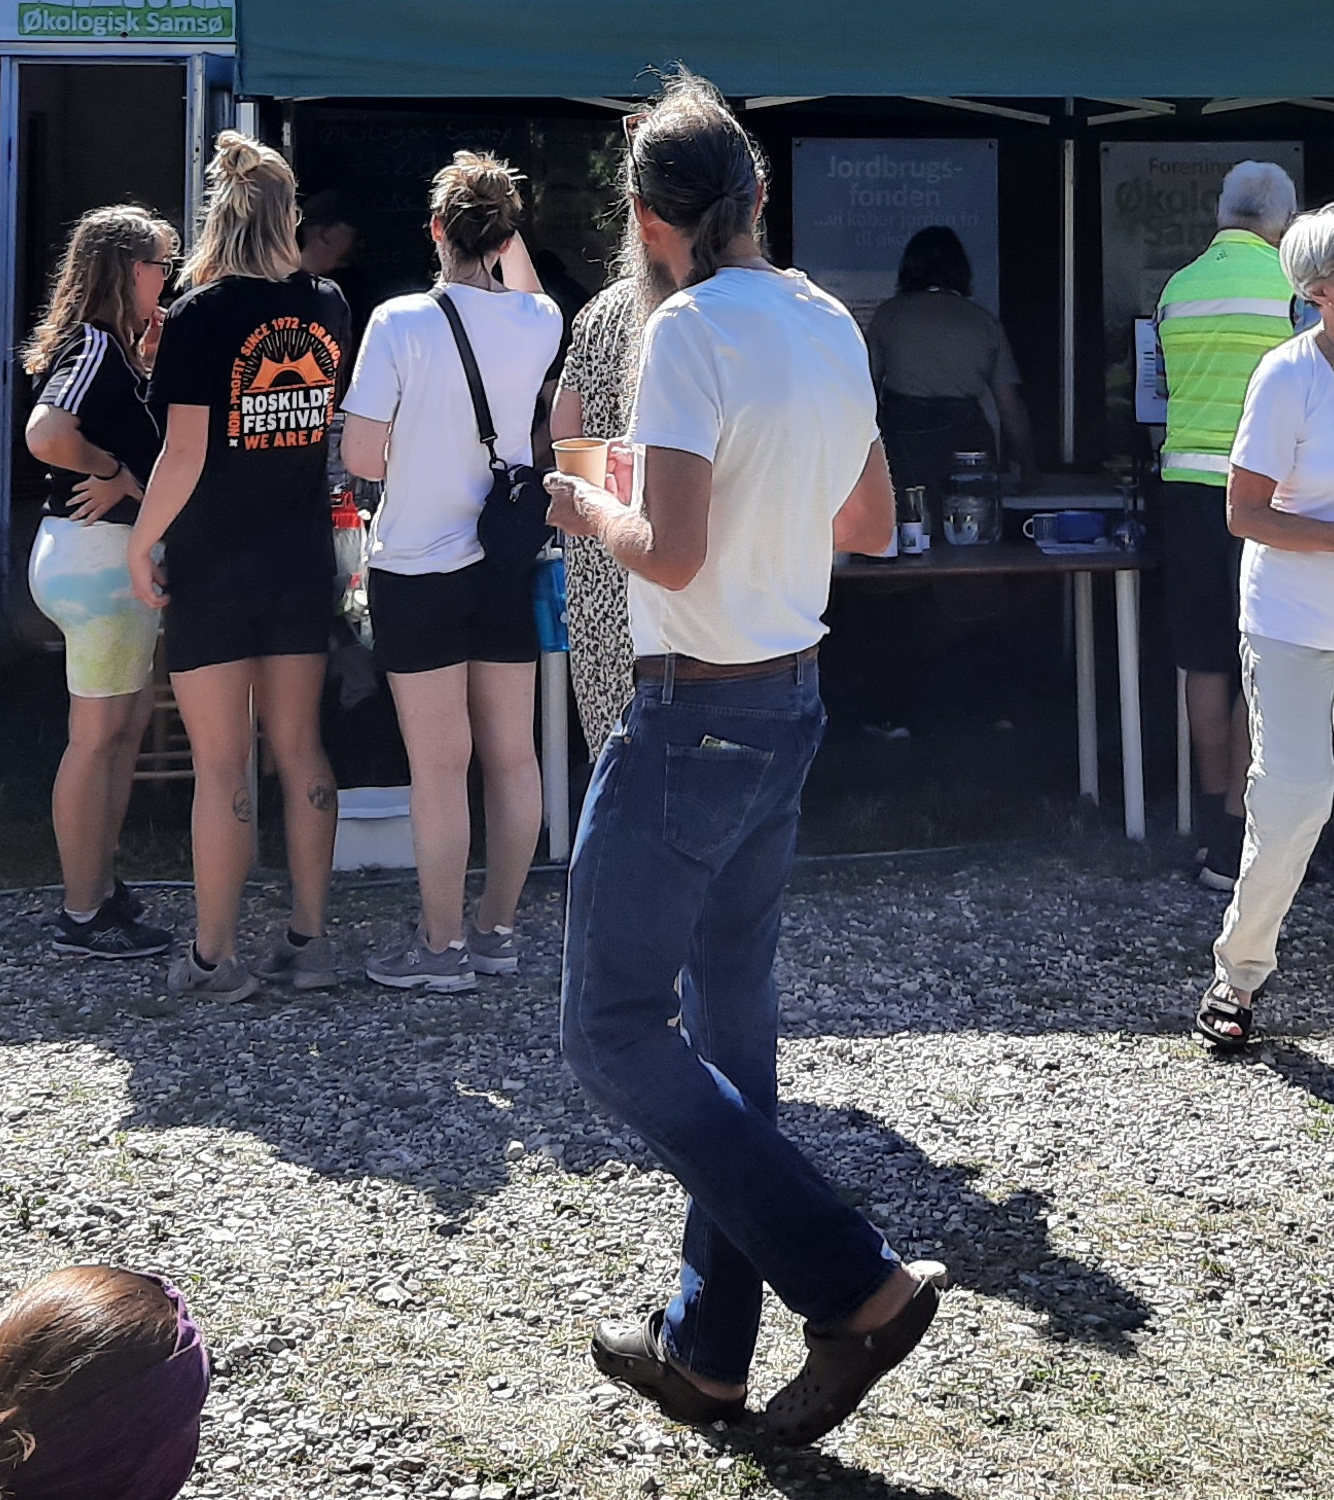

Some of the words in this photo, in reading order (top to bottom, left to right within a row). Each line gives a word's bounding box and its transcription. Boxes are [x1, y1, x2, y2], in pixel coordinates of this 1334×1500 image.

[23, 8, 140, 35] Økologisk
[145, 11, 223, 34] Samsø
[827, 154, 963, 184] Jordbrugs-
[850, 183, 941, 207] fonden
[241, 323, 271, 356] SINCE
[271, 317, 300, 330] 1972
[241, 387, 335, 414] ROSKILDE
[244, 433, 269, 450] WE
[273, 429, 309, 447] ARE
